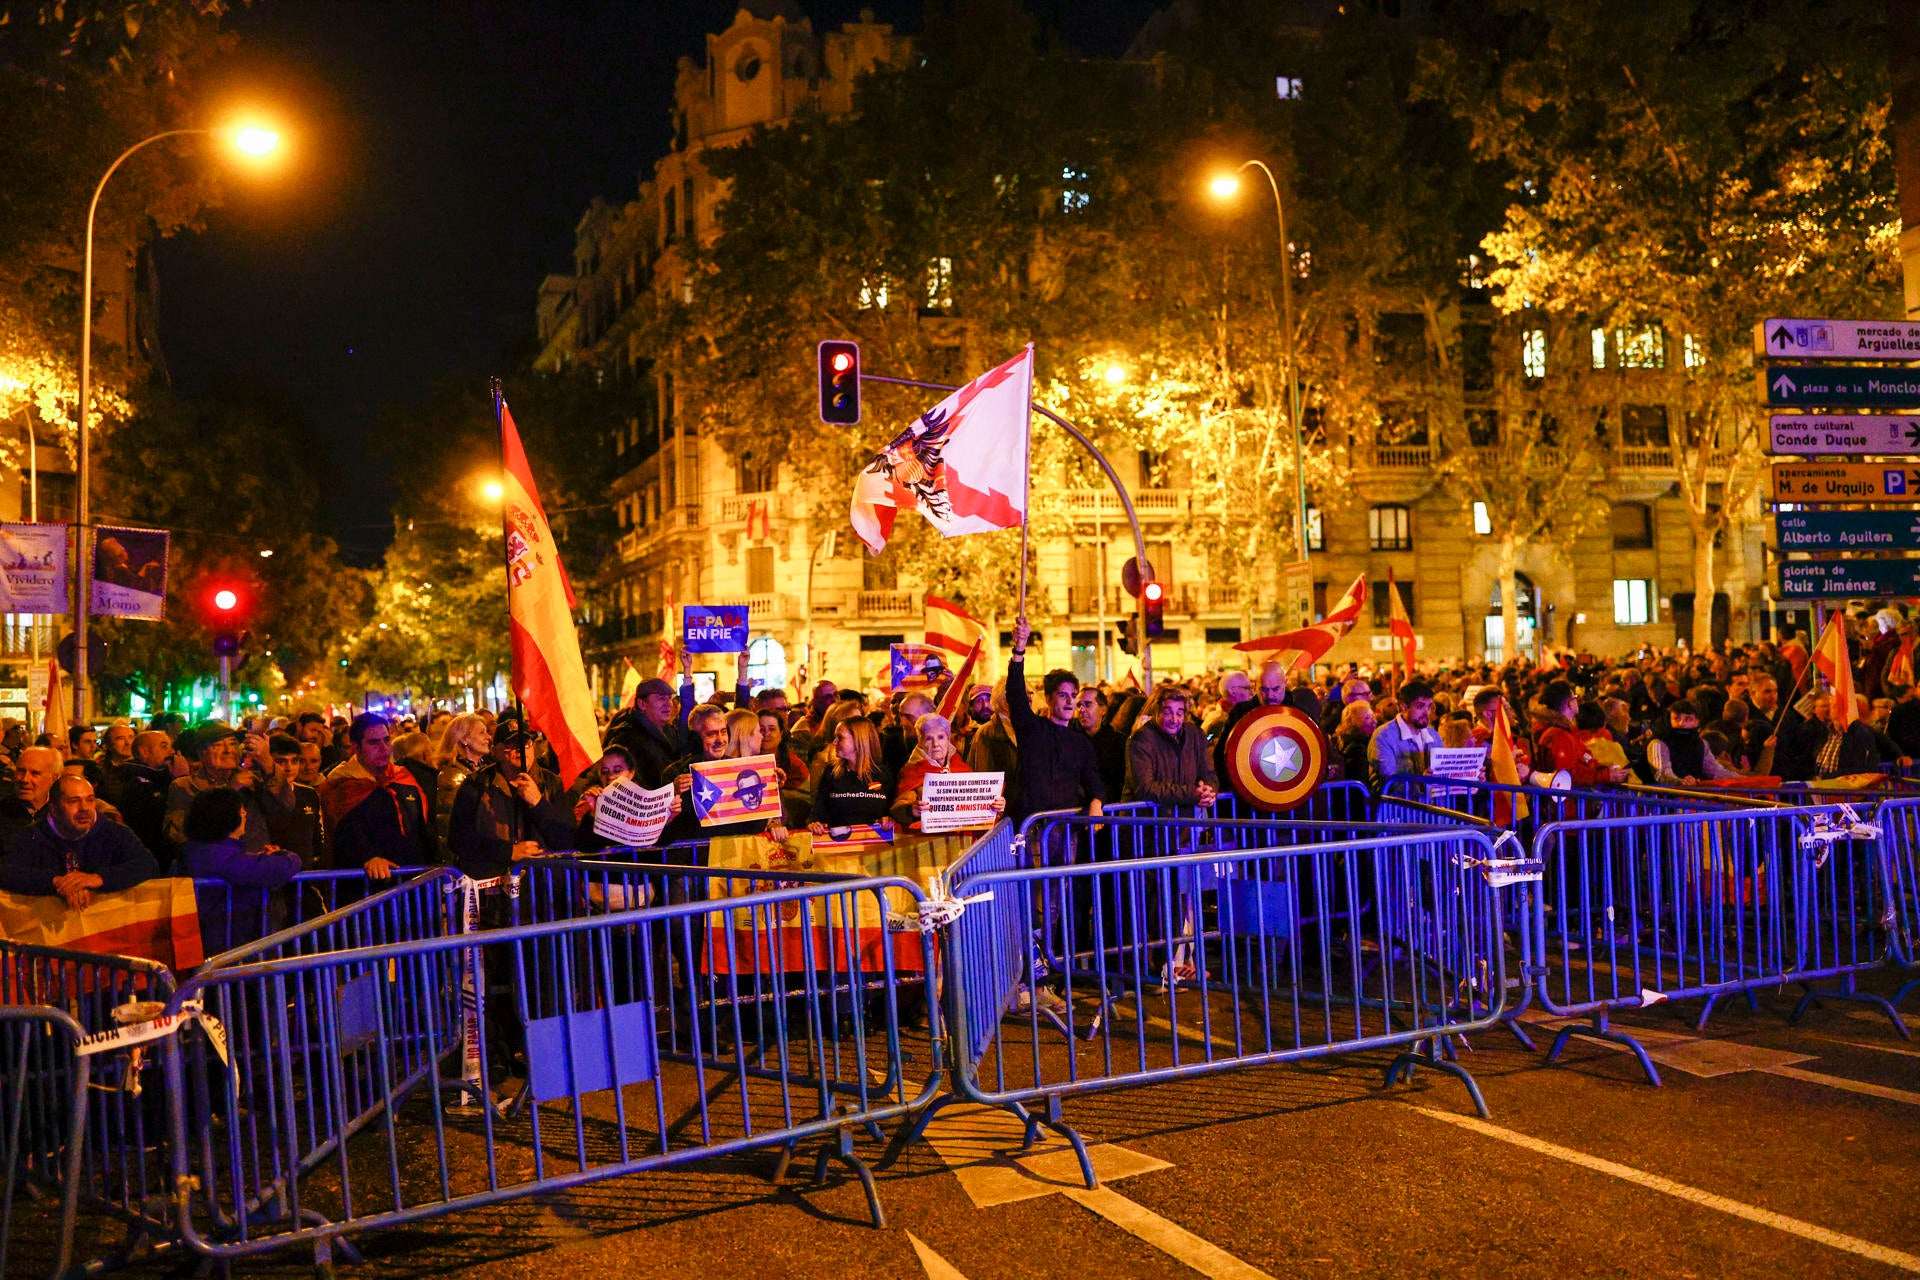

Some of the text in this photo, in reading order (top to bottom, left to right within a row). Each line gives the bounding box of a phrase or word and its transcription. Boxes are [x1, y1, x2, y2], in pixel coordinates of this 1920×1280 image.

[1857, 328, 1902, 337] mercado
[1803, 383, 1829, 394] plaza
[1835, 383, 1847, 392] de
[1853, 383, 1863, 393] la
[1775, 421, 1854, 431] centro cultural
[1776, 434, 1867, 447] Conde Duque
[1779, 469, 1847, 478] aparcamiento
[1779, 481, 1875, 496] M. de Urquijo
[1781, 518, 1807, 528] calle
[1783, 531, 1893, 545] Alberto Aguilera
[1783, 566, 1845, 578] glorieta de
[6, 574, 55, 585] Vividero
[1784, 578, 1877, 592] Ruiz Jiménez
[99, 597, 141, 610] Momo
[688, 612, 744, 627] ESPAÑA
[688, 628, 732, 640] EN PIE
[928, 803, 992, 812] QUEDAS AMNISTIAD
[600, 804, 626, 822] QUEDAS
[625, 815, 666, 828] AMNISTIADO
[74, 1027, 120, 1048] OLICIA
